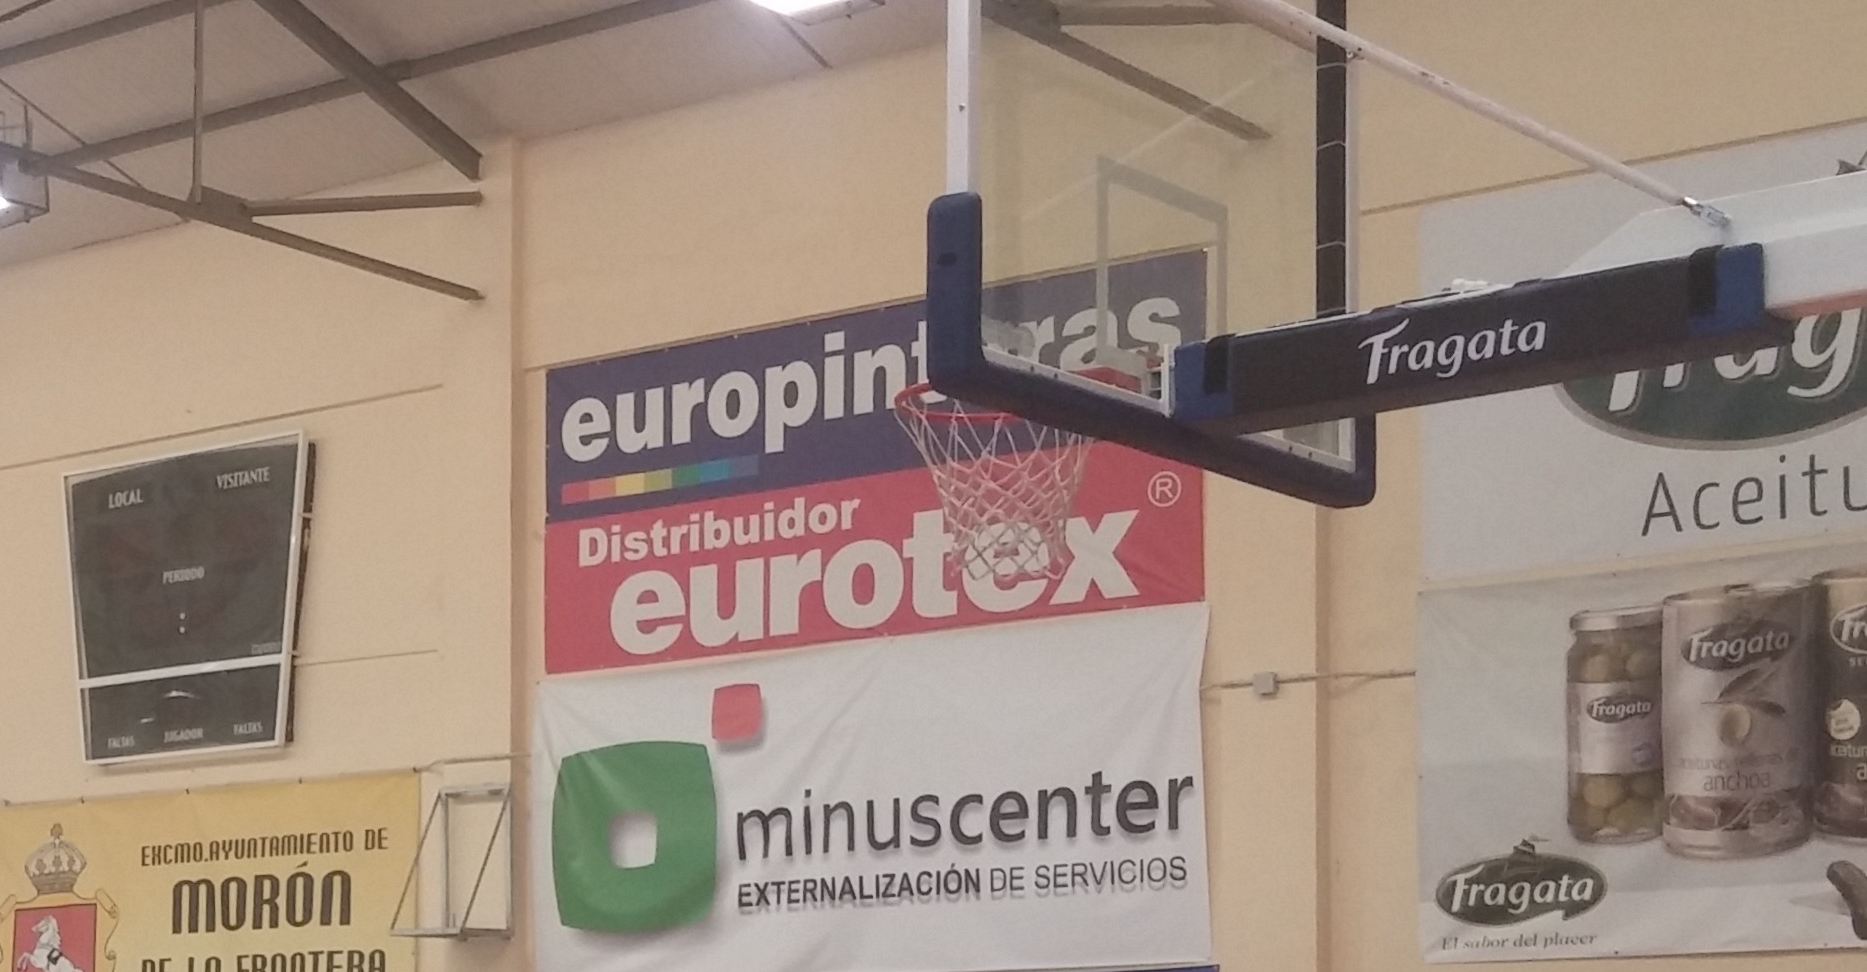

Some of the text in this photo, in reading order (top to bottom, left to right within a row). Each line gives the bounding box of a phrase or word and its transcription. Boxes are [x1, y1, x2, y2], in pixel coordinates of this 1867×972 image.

[1358, 317, 1547, 384] Fragata
[562, 297, 1182, 461] europinras
[108, 466, 270, 509] LOCAL VISITANTE
[1641, 454, 1867, 537] Aceitu
[578, 496, 861, 568] Distribuidor
[162, 566, 205, 584] PERIODO
[610, 509, 1140, 656] eurotex
[1687, 626, 1790, 662] Fragata
[1590, 699, 1652, 718] Fragata
[108, 721, 263, 749] FALTAS JUGADOR FALTAS
[1703, 771, 1771, 792] anchoa
[364, 827, 389, 850] DE
[736, 771, 1194, 861] minuscenter
[172, 861, 353, 934] MORÓN
[736, 856, 1188, 909] EXTERNALIZACIÓN DE SERVICIOS
[1448, 866, 1596, 914] Fragata
[1463, 936, 1509, 949] sabor
[1513, 934, 1538, 948] del
[1543, 932, 1598, 948] placer
